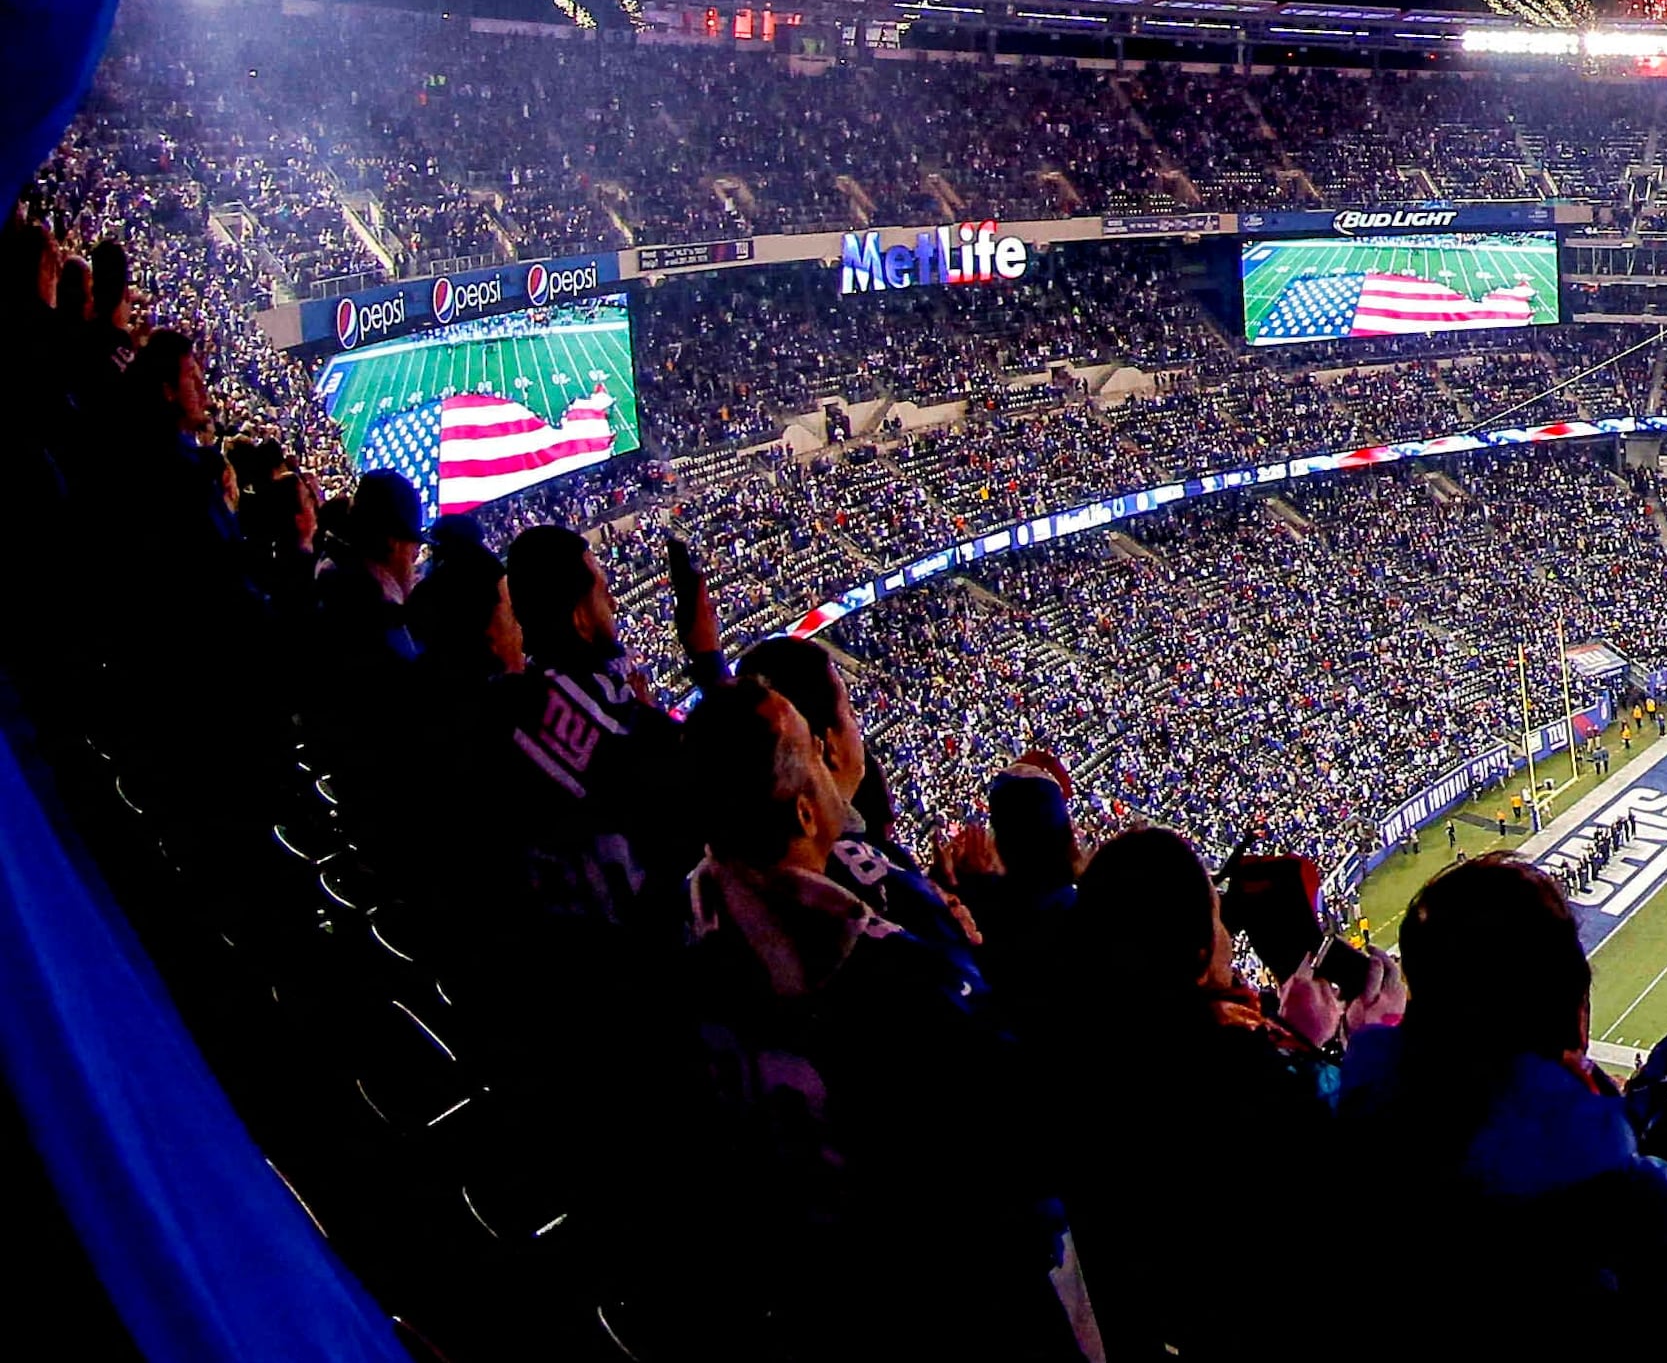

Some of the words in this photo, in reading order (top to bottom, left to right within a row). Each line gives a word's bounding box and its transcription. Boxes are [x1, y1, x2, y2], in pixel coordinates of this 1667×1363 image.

[1342, 211, 1390, 228] BUD
[1389, 210, 1458, 227] LIGHT
[548, 260, 598, 294] pepsi
[841, 219, 1027, 294] MetLife
[358, 292, 406, 333] pepsi
[453, 273, 501, 316] pepsi
